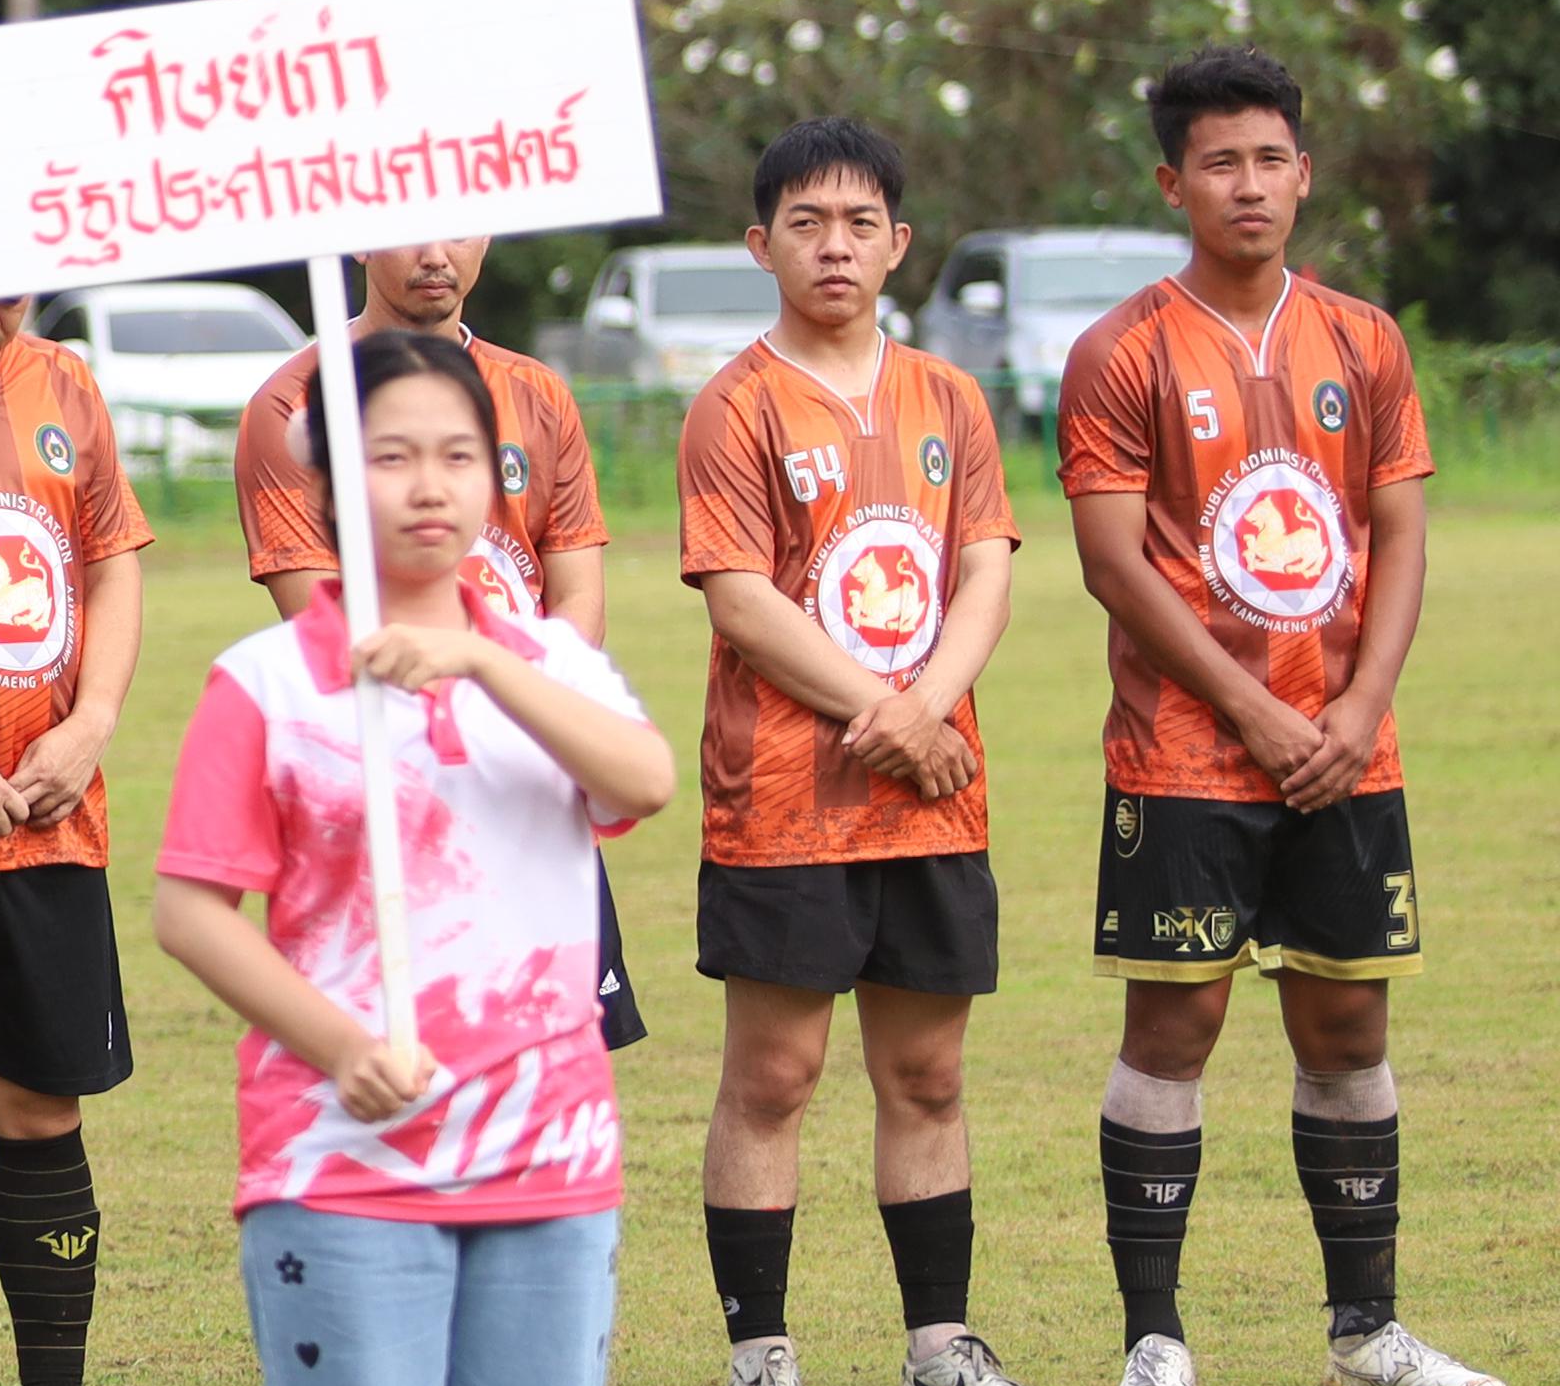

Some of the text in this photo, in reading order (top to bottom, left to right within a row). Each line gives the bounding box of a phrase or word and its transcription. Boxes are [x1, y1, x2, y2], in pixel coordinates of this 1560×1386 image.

[90, 7, 390, 140] ศิษย์เก่า
[29, 87, 590, 267] รัฐประศาสนศาสตร์
[1186, 389, 1220, 441] 5
[783, 443, 845, 503] 64
[1200, 469, 1238, 528] PUBLIC
[1229, 601, 1308, 633] KAMPHAENG
[1312, 608, 1336, 630] PHET
[43, 661, 64, 684] PHET
[1384, 869, 1418, 951] 3
